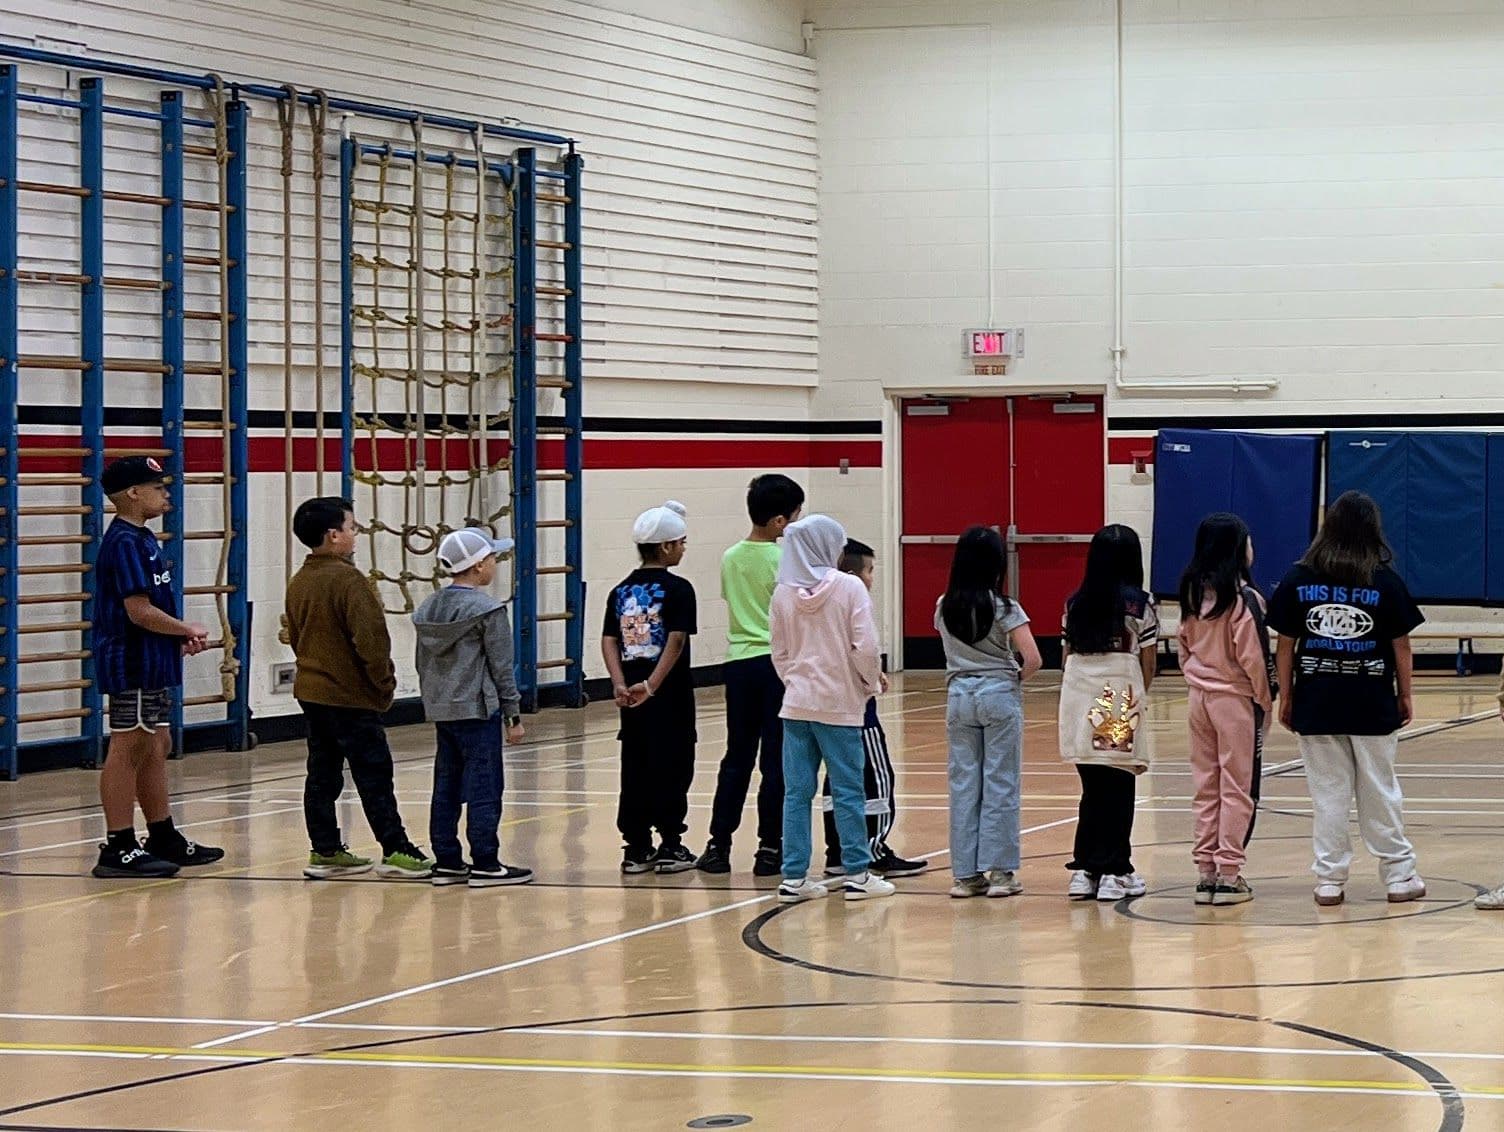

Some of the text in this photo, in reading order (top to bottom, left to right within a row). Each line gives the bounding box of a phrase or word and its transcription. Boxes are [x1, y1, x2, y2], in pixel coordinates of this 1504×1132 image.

[973, 332, 1005, 354] EXIT
[1296, 584, 1380, 606] THIS IS FOR
[1305, 638, 1377, 653] WORLD TOUR
